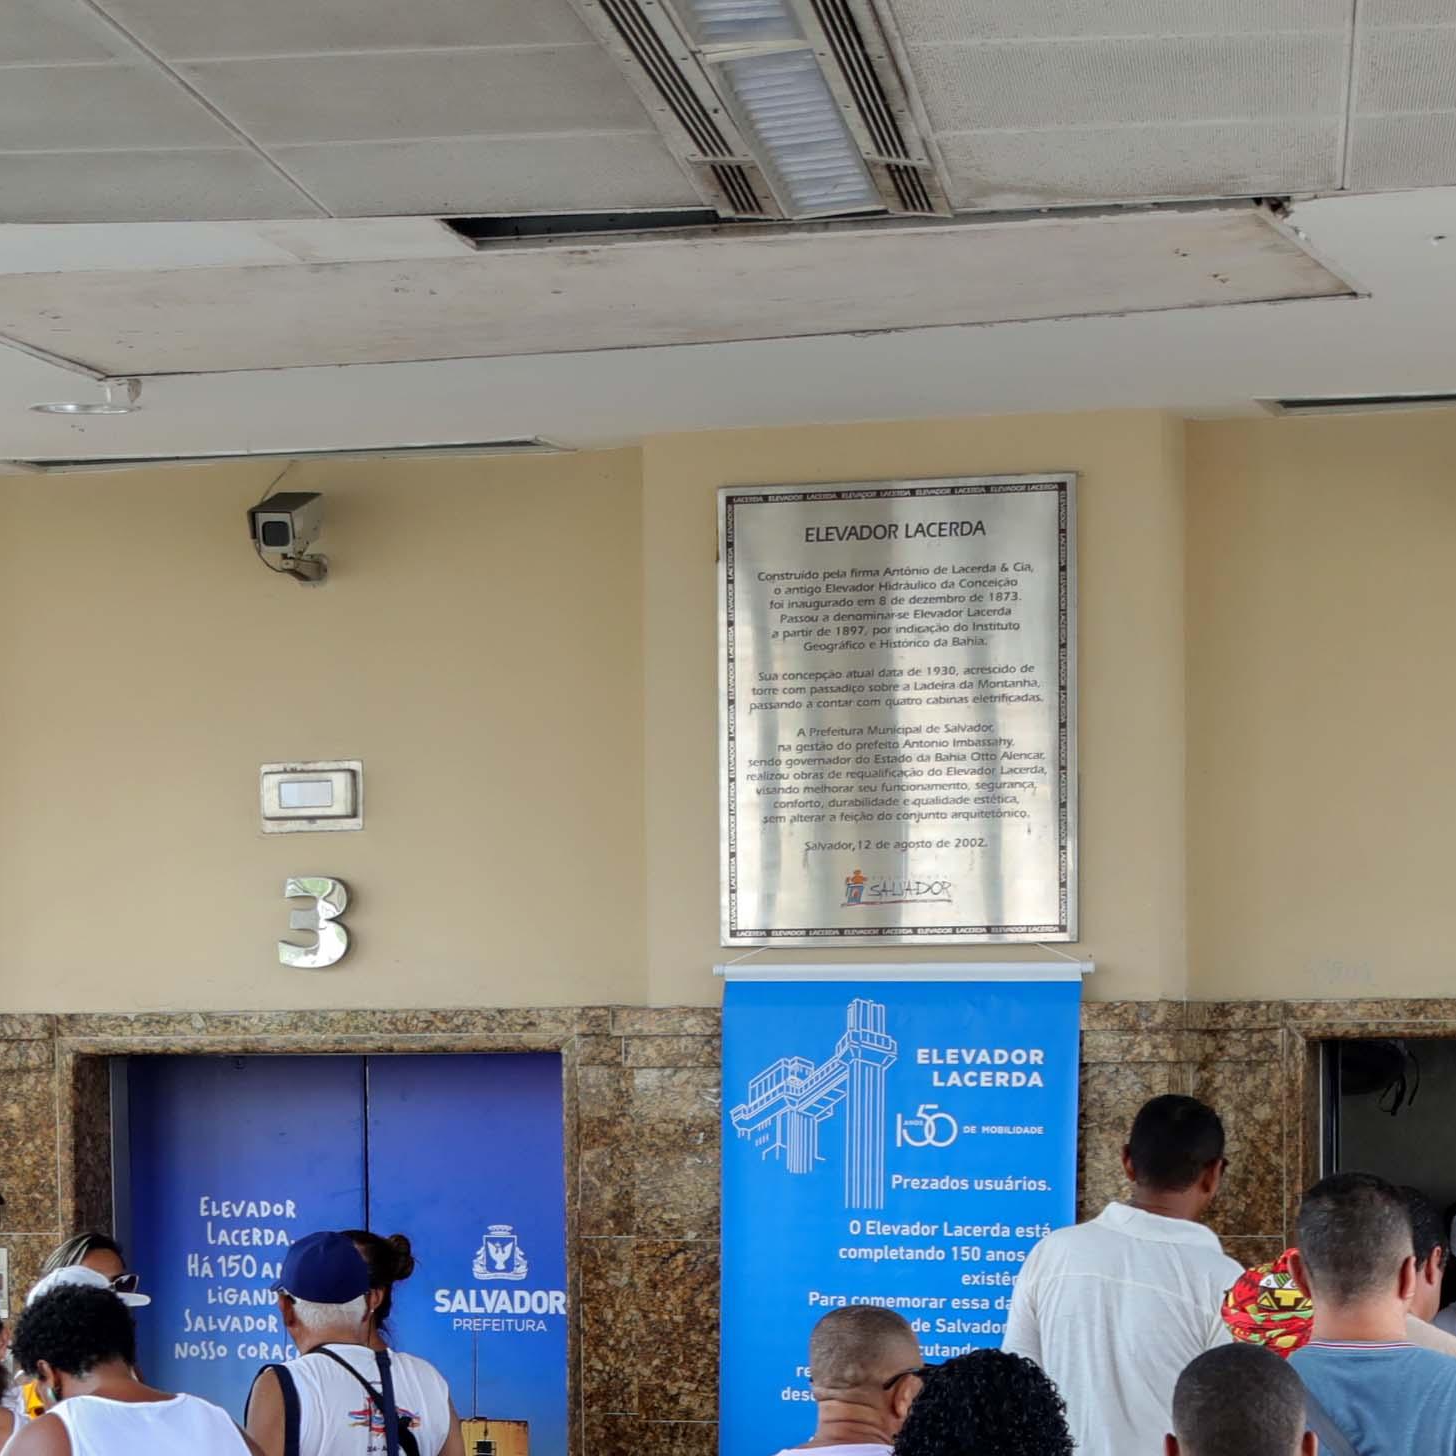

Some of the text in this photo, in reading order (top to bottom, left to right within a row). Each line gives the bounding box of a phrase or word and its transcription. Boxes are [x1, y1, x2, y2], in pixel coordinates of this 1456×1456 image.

[805, 521, 985, 541] ELEVADOR LACERDA
[822, 569, 846, 580] pela
[850, 568, 879, 577] firma
[933, 566, 947, 575] de
[951, 565, 995, 574] Lacerda
[784, 584, 821, 596] antigo
[825, 583, 874, 592] Elevador
[940, 580, 954, 589] da
[769, 599, 783, 608] foi
[788, 598, 853, 609] inaugurado
[890, 596, 904, 605] de
[908, 595, 966, 604] dezembro
[969, 594, 983, 603] de
[779, 607, 1011, 622] Passou denominar-se Elevador Lacerda
[782, 628, 812, 639] partir
[816, 627, 831, 636] de
[872, 627, 891, 636] por
[952, 623, 968, 632] do
[972, 622, 1020, 632] Instituto
[933, 638, 947, 647] da
[758, 672, 778, 680] Sua
[845, 669, 874, 678] atual
[878, 668, 903, 677] data
[906, 668, 921, 676] de
[963, 665, 1016, 675] acrescido
[1019, 664, 1034, 673] de
[751, 685, 778, 694] torre
[781, 686, 806, 694] com
[868, 682, 899, 691] sobre
[913, 681, 955, 690] Ladeira
[749, 699, 802, 710] passando
[816, 698, 852, 707] contar
[885, 696, 922, 707] quatro
[925, 695, 968, 705] cabinas
[809, 727, 863, 736] Prefeitura
[867, 725, 921, 736] Municipal
[836, 741, 851, 750] do
[855, 740, 899, 751] prefeito
[902, 739, 949, 748] Antonio
[747, 757, 781, 766] sendo
[784, 756, 851, 767] governador
[873, 754, 912, 763] Estado
[934, 753, 966, 762] Bahia
[970, 752, 997, 761] Otto
[746, 771, 789, 780] realizou
[792, 770, 823, 779] obras
[827, 770, 841, 778] de
[945, 767, 995, 776] Elevador
[755, 784, 799, 793] visando
[803, 783, 854, 792] melhorar
[828, 797, 898, 807] durabilidade
[911, 796, 970, 807] qualidade
[789, 813, 825, 822] alterar
[895, 811, 947, 822] conjunto
[858, 840, 871, 849] 12
[875, 840, 889, 849] de
[893, 839, 932, 850] agosto
[935, 839, 950, 848] de
[868, 881, 952, 898] SALVADOR
[279, 877, 350, 969] 3
[917, 1048, 1044, 1065] ELEVADOR
[932, 1071, 1044, 1087] LACERDA
[896, 1104, 1044, 1147] 150 DE MOBILIDADE
[891, 1174, 1051, 1191] Prezados usuários.
[200, 1196, 296, 1219] ELEVADOR
[207, 1221, 295, 1246] LACERDA.
[849, 1220, 1051, 1238] O Elevador Lacerda está
[839, 1246, 1025, 1263] completando 150 anos
[187, 1253, 214, 1279] HÁ
[216, 1254, 257, 1278] 150
[434, 1289, 567, 1315] SALVADOR
[809, 1291, 847, 1307] Para
[851, 1293, 947, 1309] comemorar
[951, 1297, 989, 1310] essa
[184, 1308, 278, 1333] SALVADOR
[453, 1318, 547, 1332] PREFEITURA
[912, 1319, 1008, 1334] de Salvador
[175, 1341, 228, 1360] NOSSO
